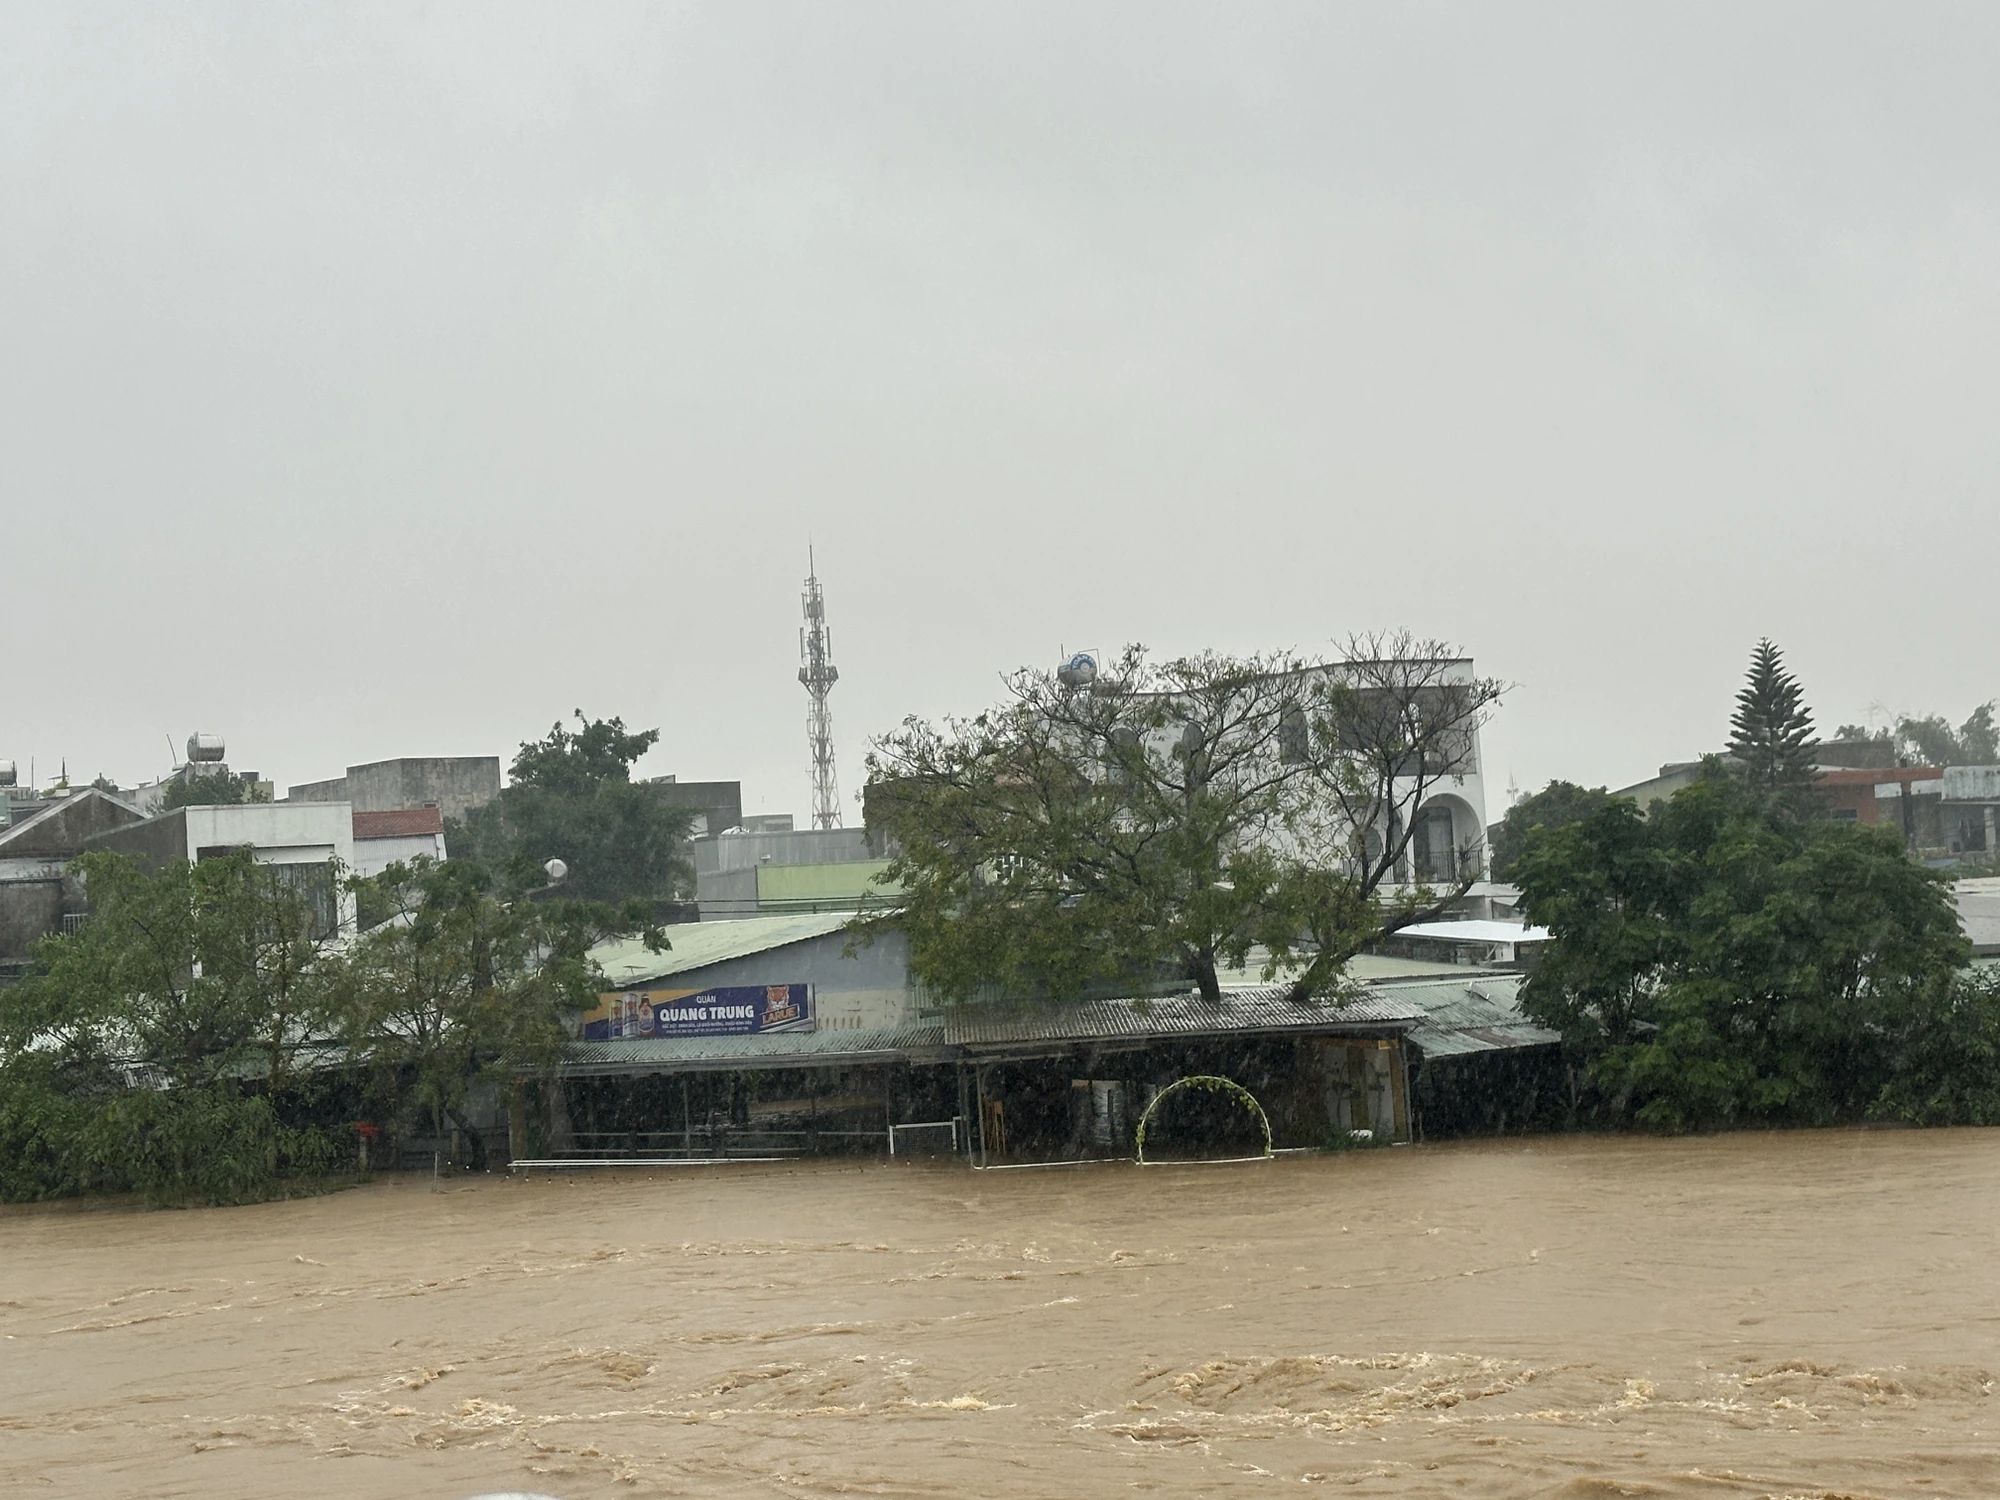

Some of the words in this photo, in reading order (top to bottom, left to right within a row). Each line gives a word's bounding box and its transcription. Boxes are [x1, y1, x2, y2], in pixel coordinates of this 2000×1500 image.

[660, 1007, 706, 1022] QUANG
[709, 1005, 754, 1019] TRUNG
[762, 1007, 796, 1025] LARUE
